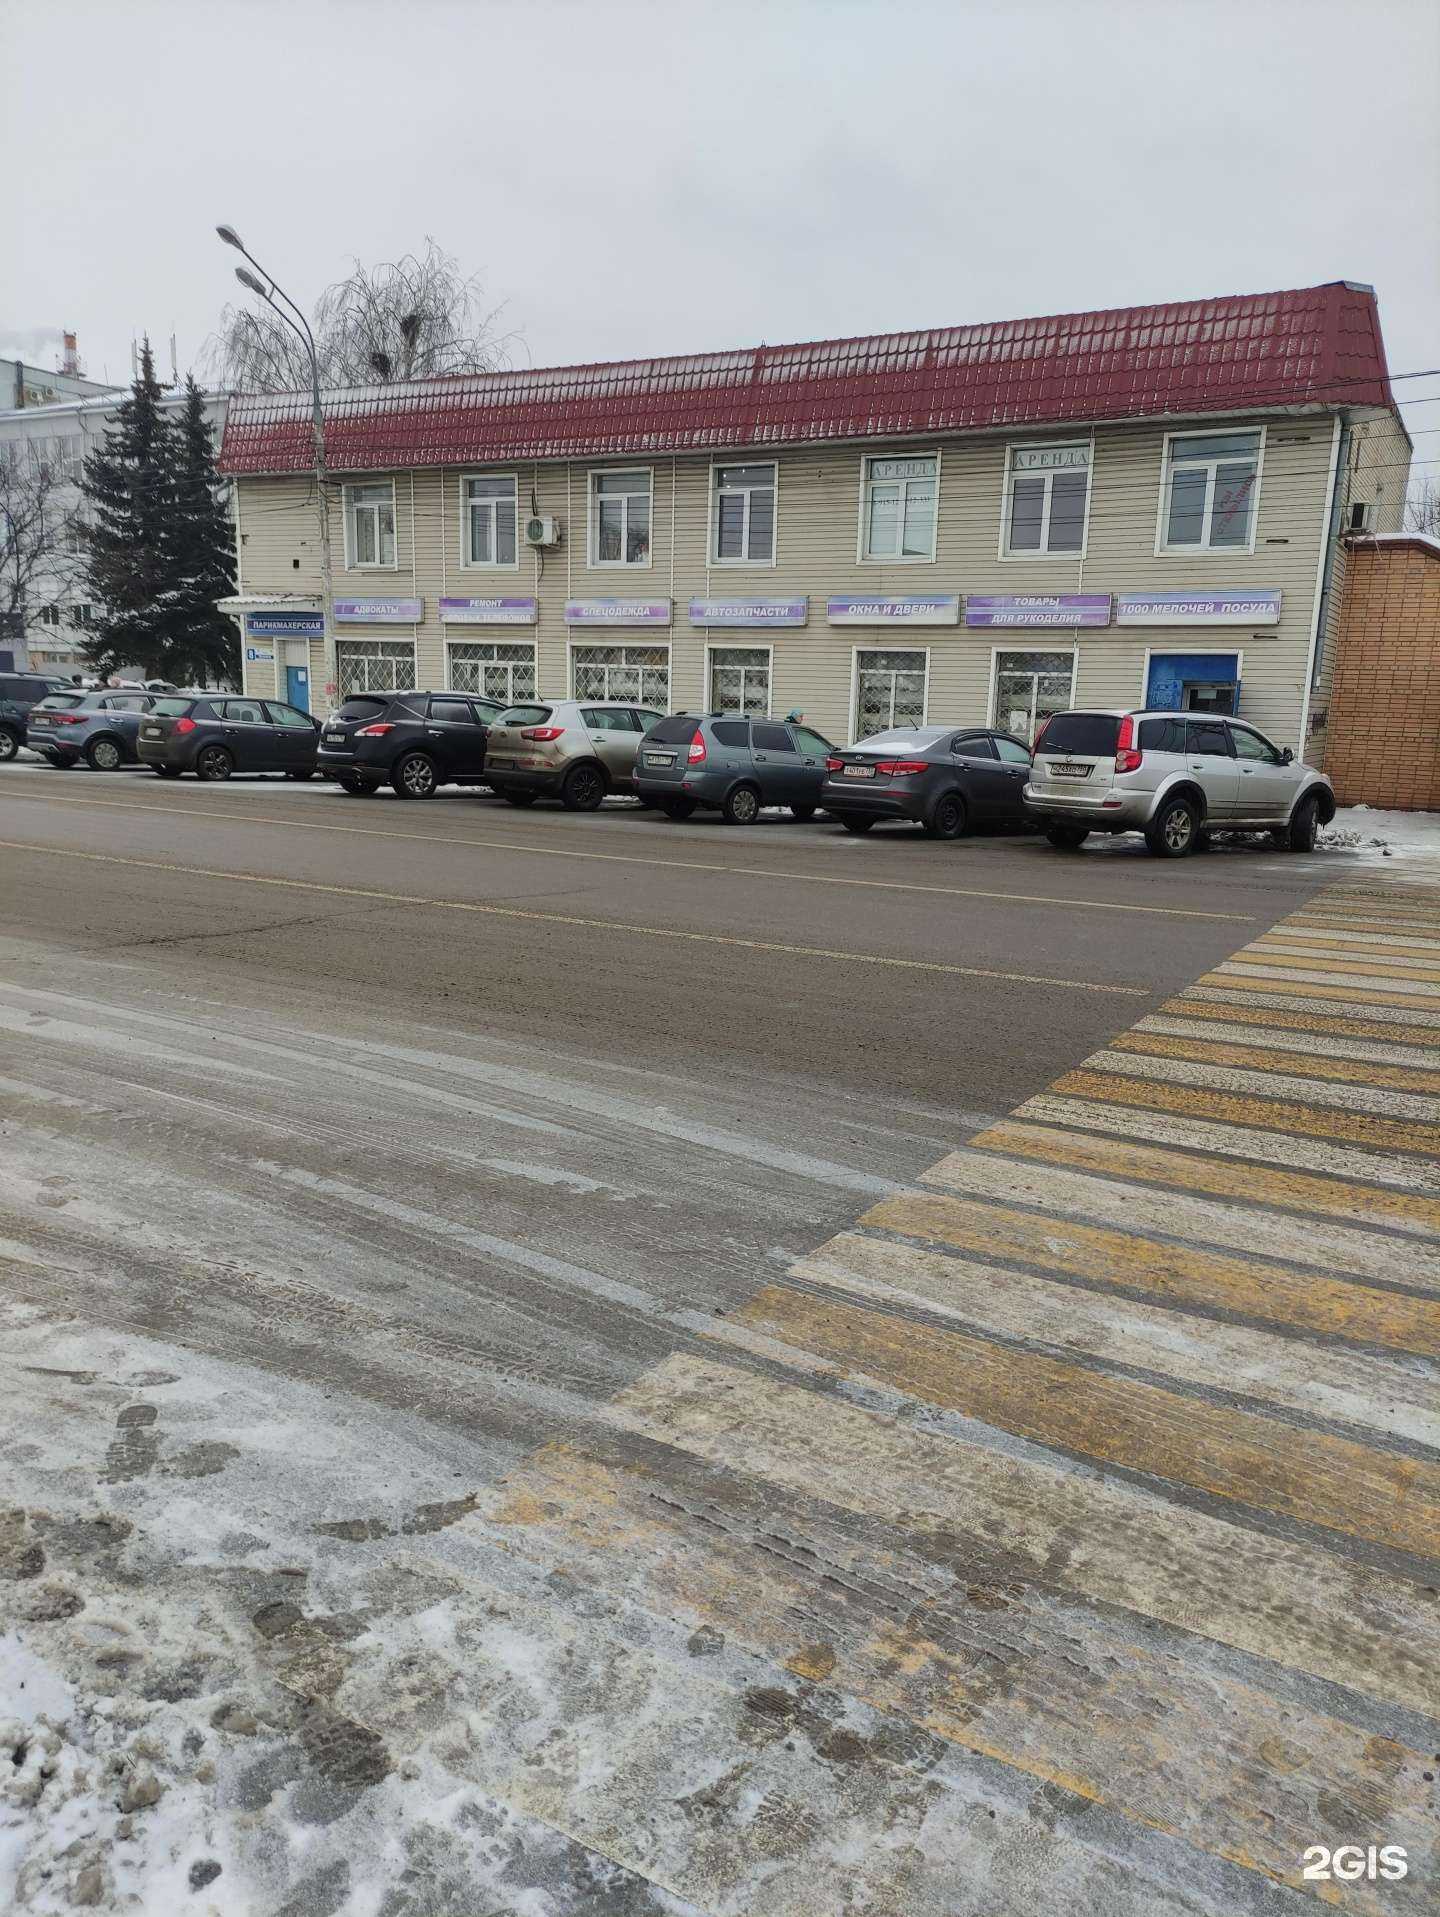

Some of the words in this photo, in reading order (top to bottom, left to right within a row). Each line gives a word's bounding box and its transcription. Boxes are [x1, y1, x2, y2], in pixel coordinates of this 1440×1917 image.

[1014, 451, 1088, 468] АРЕНДА
[469, 599, 503, 609] РЕМОНТ
[1014, 596, 1060, 606] ТОВАРЫ
[353, 605, 400, 614] АДВОКАТЫ
[582, 606, 651, 617] СПЕЦОДЕЖДА
[704, 607, 790, 617] АВТОЗАПЧАСТИ
[848, 604, 881, 616] ОКНА
[883, 604, 891, 615] И
[893, 603, 936, 617] ДВЕРИ
[1121, 603, 1149, 614] 1000
[1151, 601, 1214, 614] МЕЛОЧЕЙ
[1221, 602, 1275, 613] ПОСУДА
[992, 613, 1012, 625] ДЛЯ
[1015, 613, 1082, 624] РУКОДЕЛИЯ
[253, 621, 321, 631] ПАРИКМАХЕРСКАЯ
